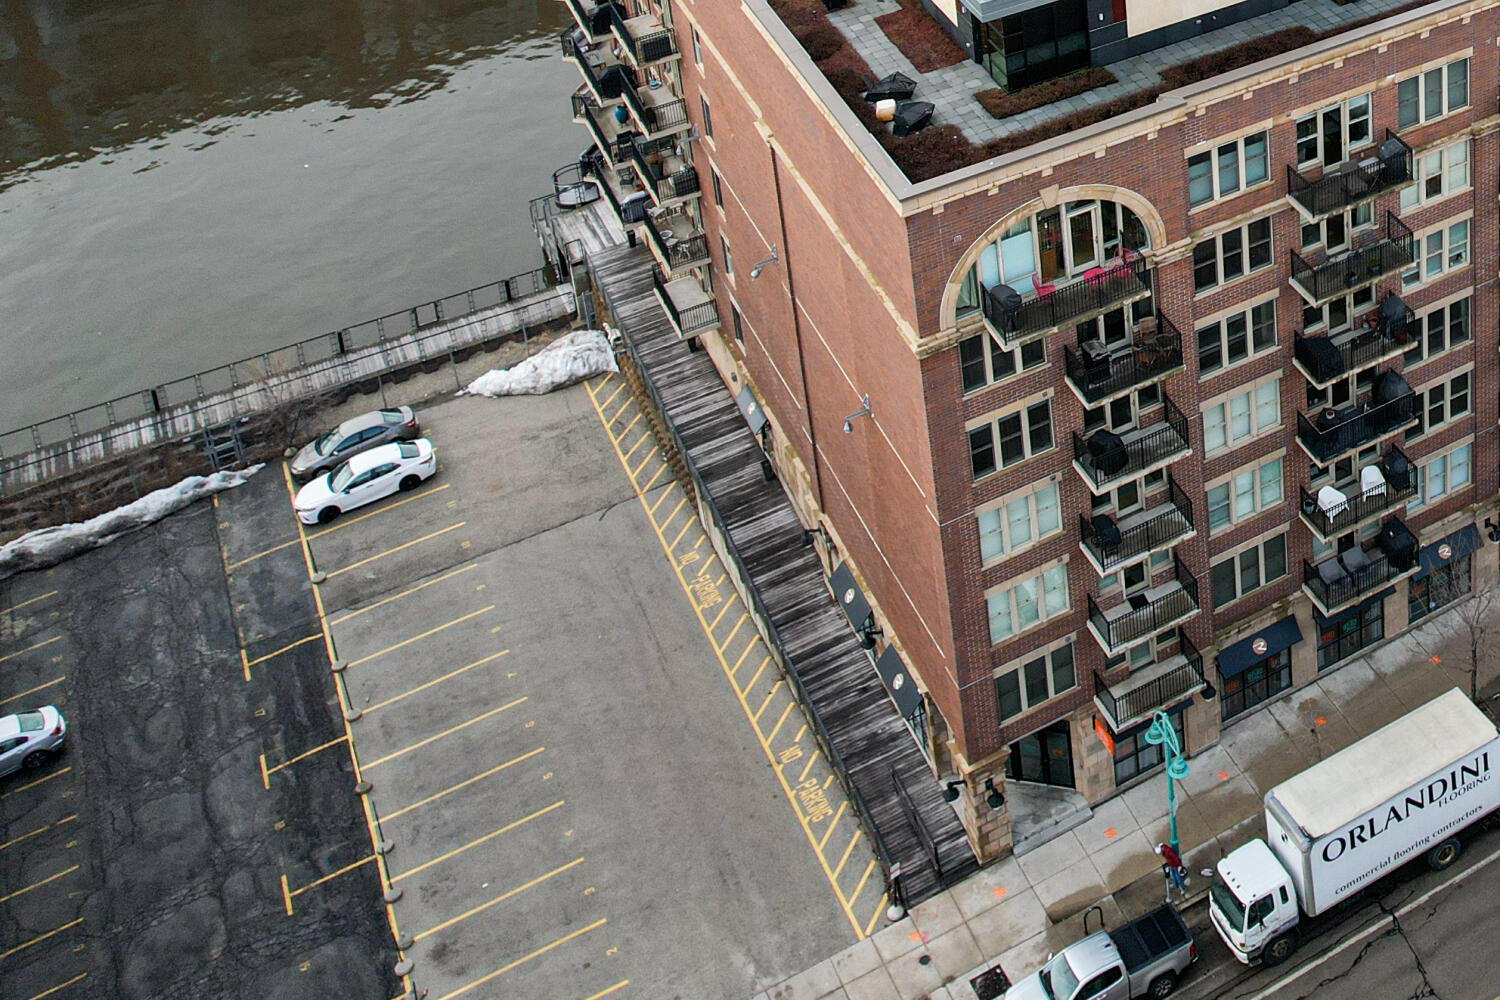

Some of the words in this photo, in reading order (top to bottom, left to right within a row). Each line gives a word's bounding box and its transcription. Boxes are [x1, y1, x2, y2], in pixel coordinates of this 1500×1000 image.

[679, 550, 700, 565] NO
[691, 574, 723, 609] PARKING
[779, 745, 803, 764] NO
[796, 777, 834, 824] PARKING
[1322, 751, 1490, 863] ORLANDINI
[1438, 773, 1491, 809] FLOORING
[1335, 857, 1391, 896] commercial
[1393, 834, 1431, 864] flooring
[1432, 804, 1483, 839] contractors
